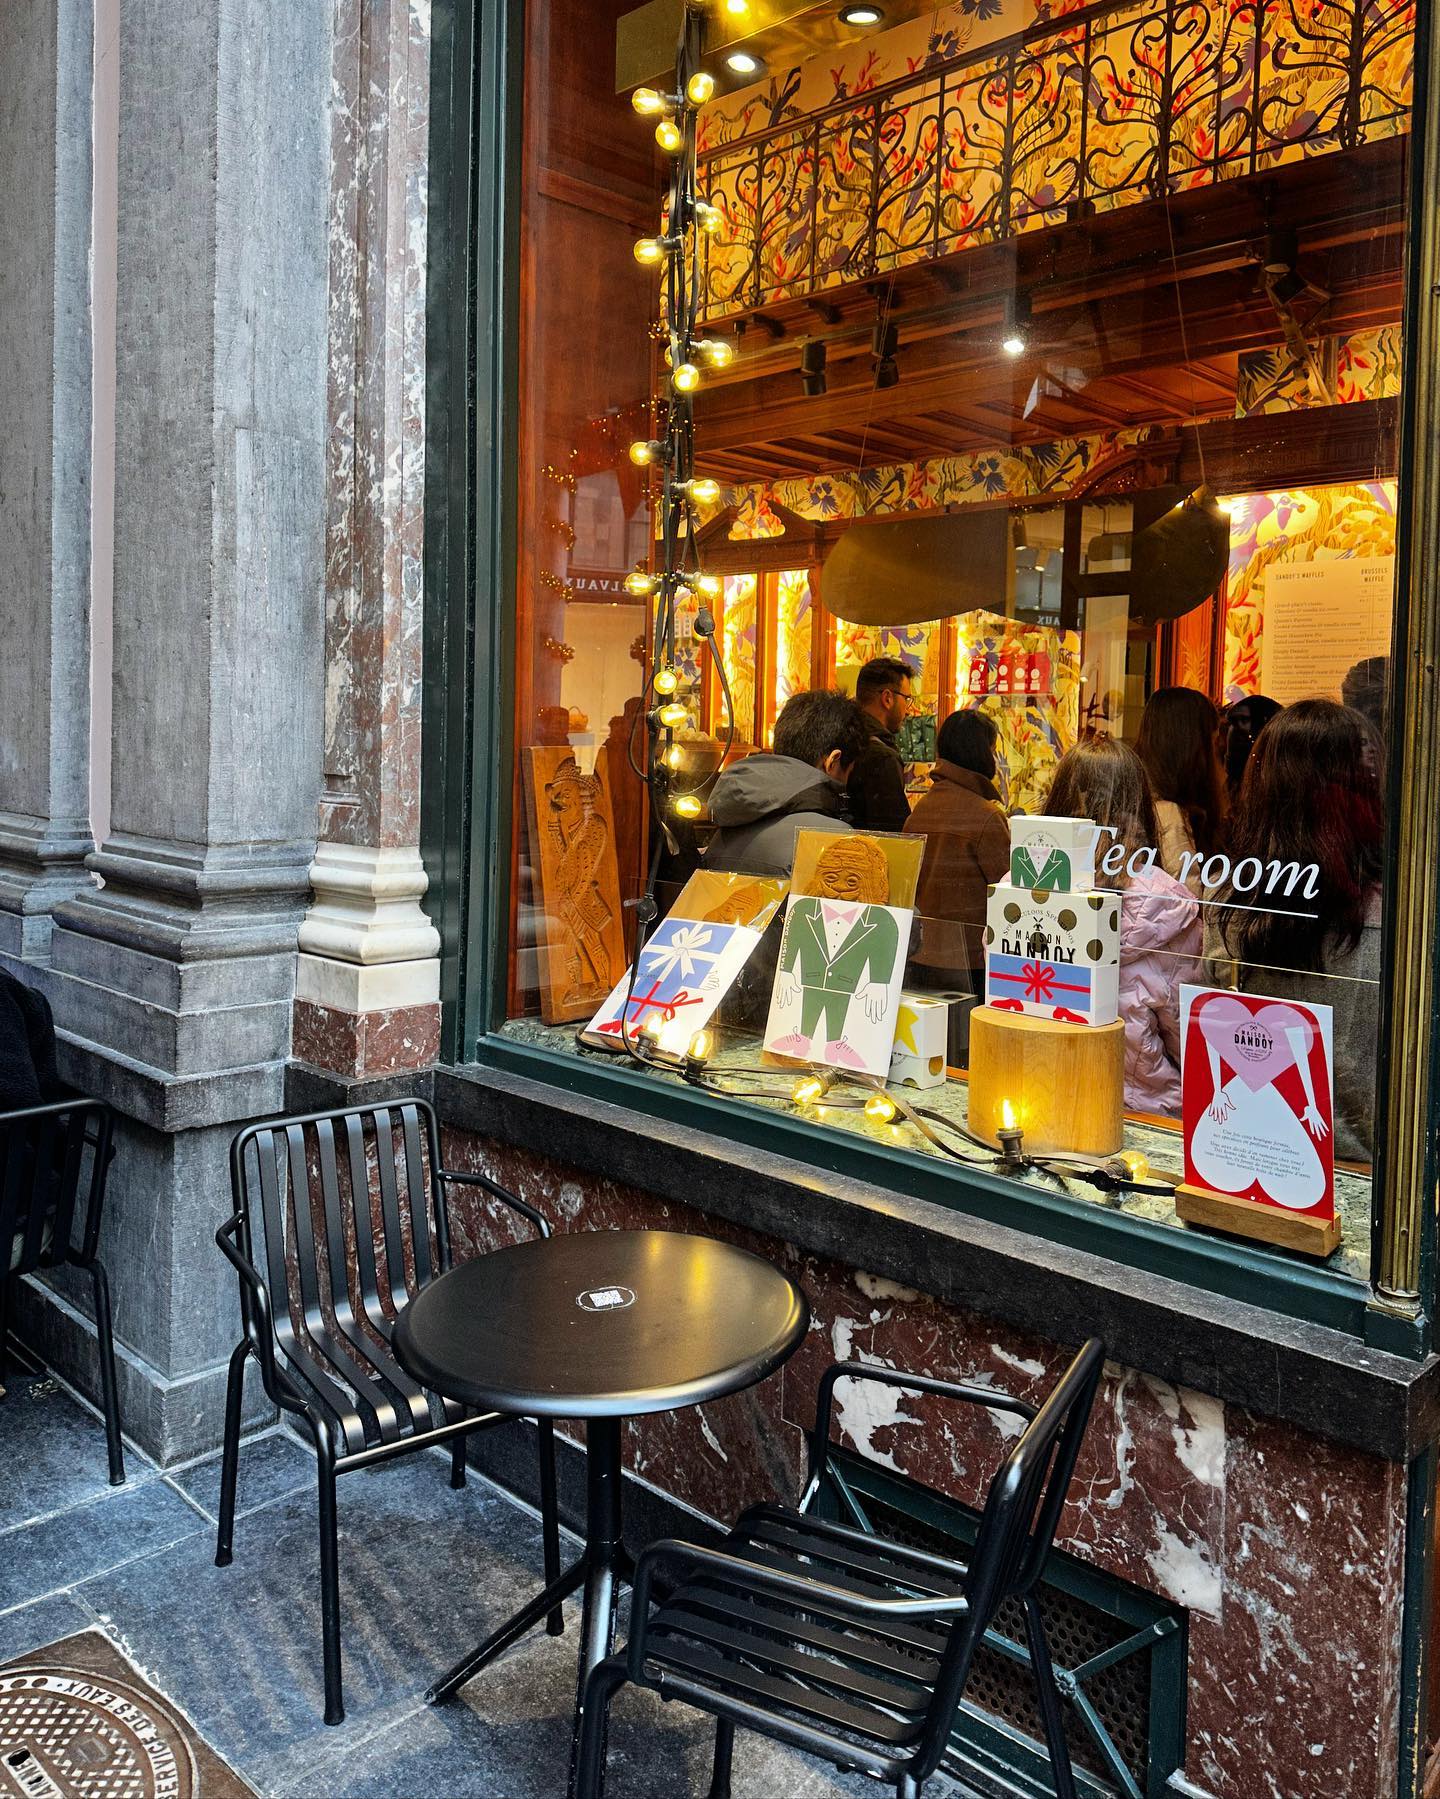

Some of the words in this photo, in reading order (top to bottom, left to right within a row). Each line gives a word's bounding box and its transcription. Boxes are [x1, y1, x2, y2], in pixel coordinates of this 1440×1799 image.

[1078, 825, 1158, 880] Tea
[1178, 850, 1321, 900] room
[1015, 928, 1061, 945] MAISON
[780, 940, 788, 970] MAISON
[1001, 938, 1076, 965] DANDOY
[1234, 1034, 1274, 1051] DANDOY
[1241, 1030, 1266, 1039] MAISON
[64, 1680, 118, 1708] EAUX
[112, 1703, 151, 1732] DES
